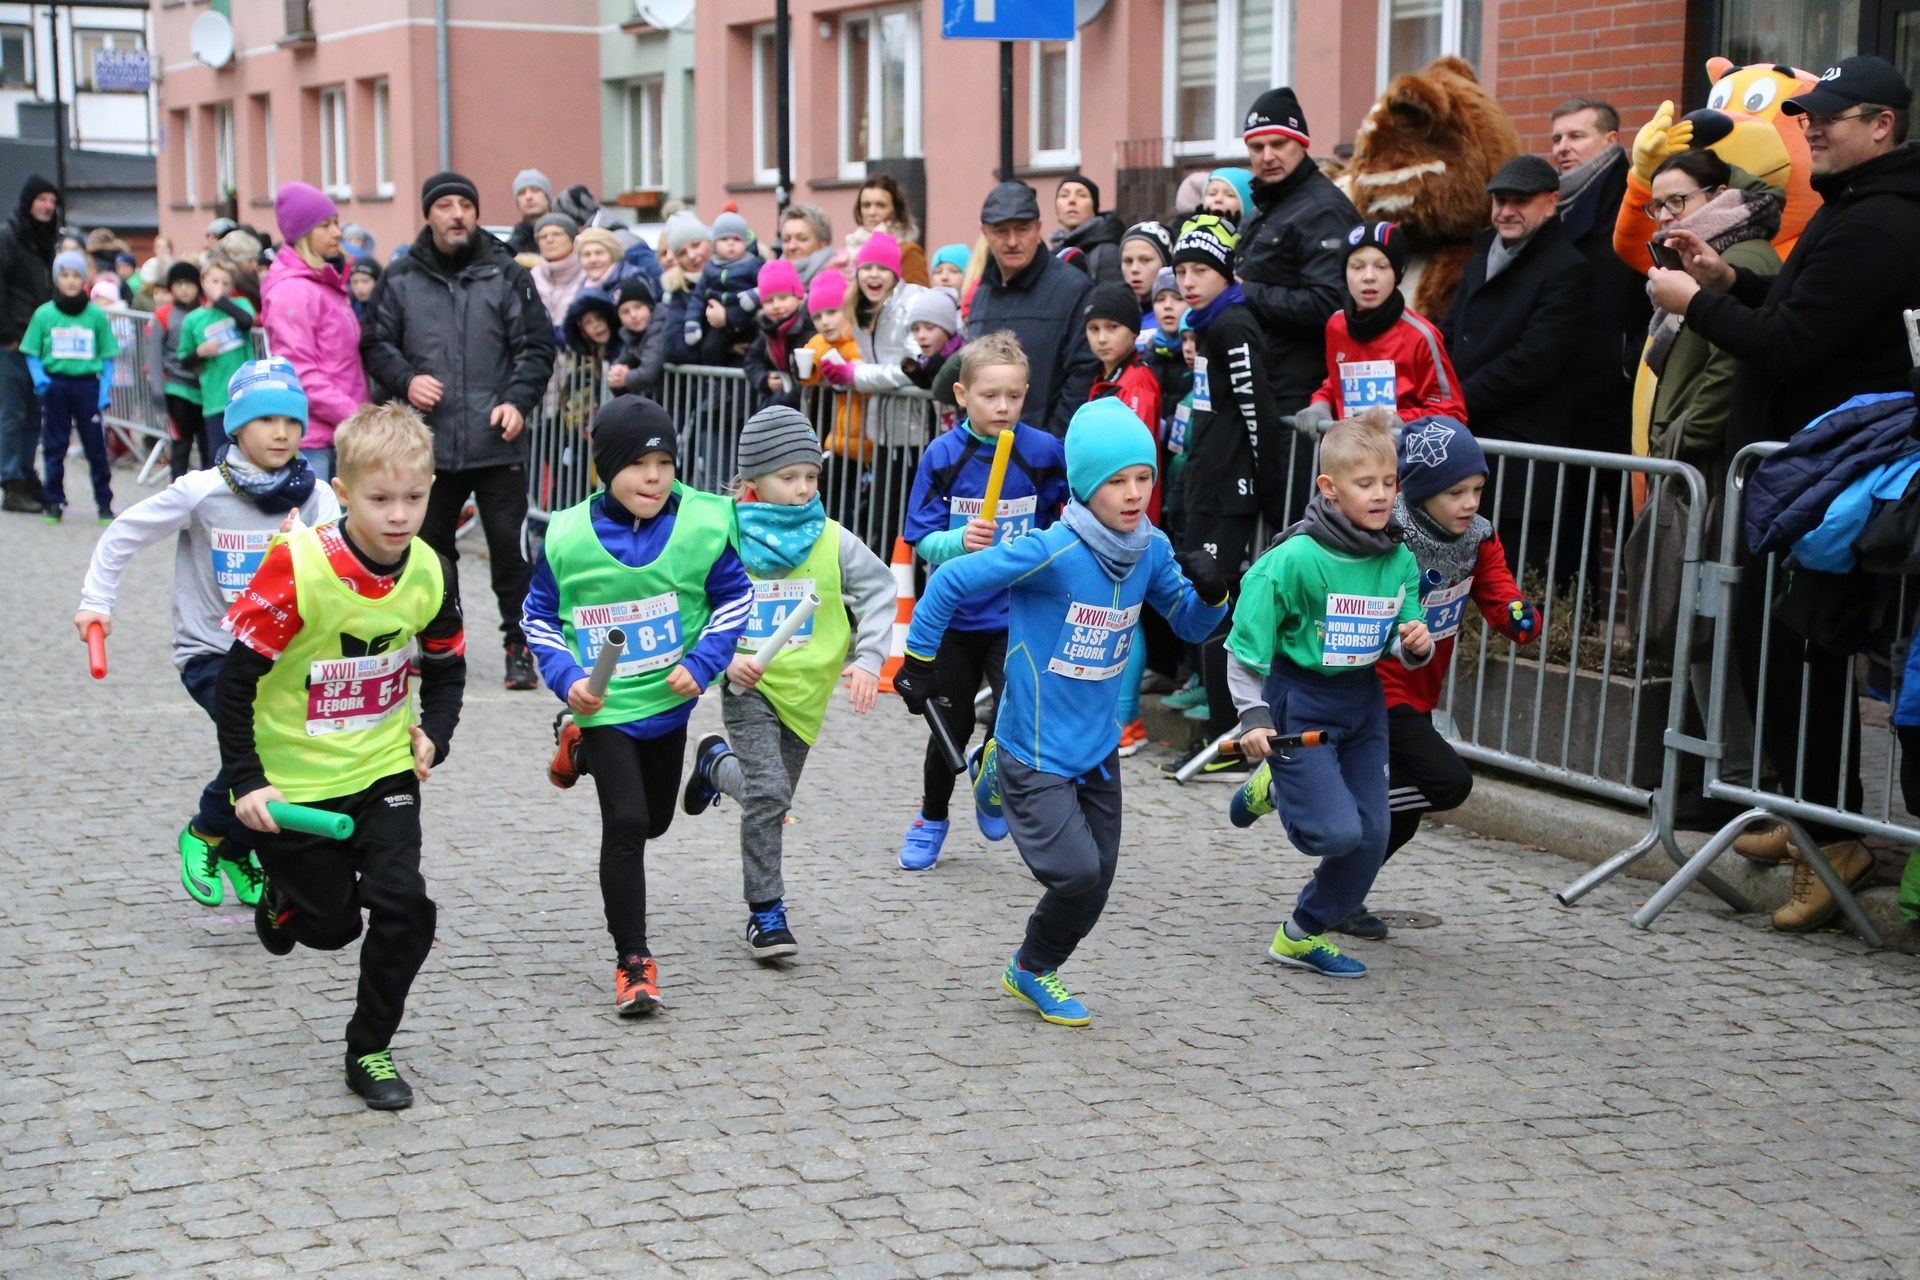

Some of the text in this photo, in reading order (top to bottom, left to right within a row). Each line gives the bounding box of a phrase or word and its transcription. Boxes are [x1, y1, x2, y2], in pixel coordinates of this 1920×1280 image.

[1366, 380, 1394, 401] 3-4
[1001, 518, 1028, 543] 2-1
[217, 533, 245, 550] XXVII
[226, 552, 246, 569] SP
[250, 592, 289, 621] SYSTEM
[1335, 598, 1365, 615] XXVII
[1434, 600, 1463, 628] 3-1
[580, 607, 611, 627] XXVII
[1075, 607, 1108, 627] XXVII
[1328, 620, 1380, 634] NOWA WIEŚ
[588, 627, 607, 645] SP
[638, 618, 677, 652] 8-1
[1071, 626, 1110, 646] SJSP
[1325, 632, 1380, 650] LĘBORSKA
[1063, 641, 1107, 660] LĘBORK
[321, 659, 378, 681] XXVII BIEGI
[323, 681, 362, 698] SP 5
[378, 667, 408, 707] 5-1
[316, 696, 366, 717] LĘBORK
